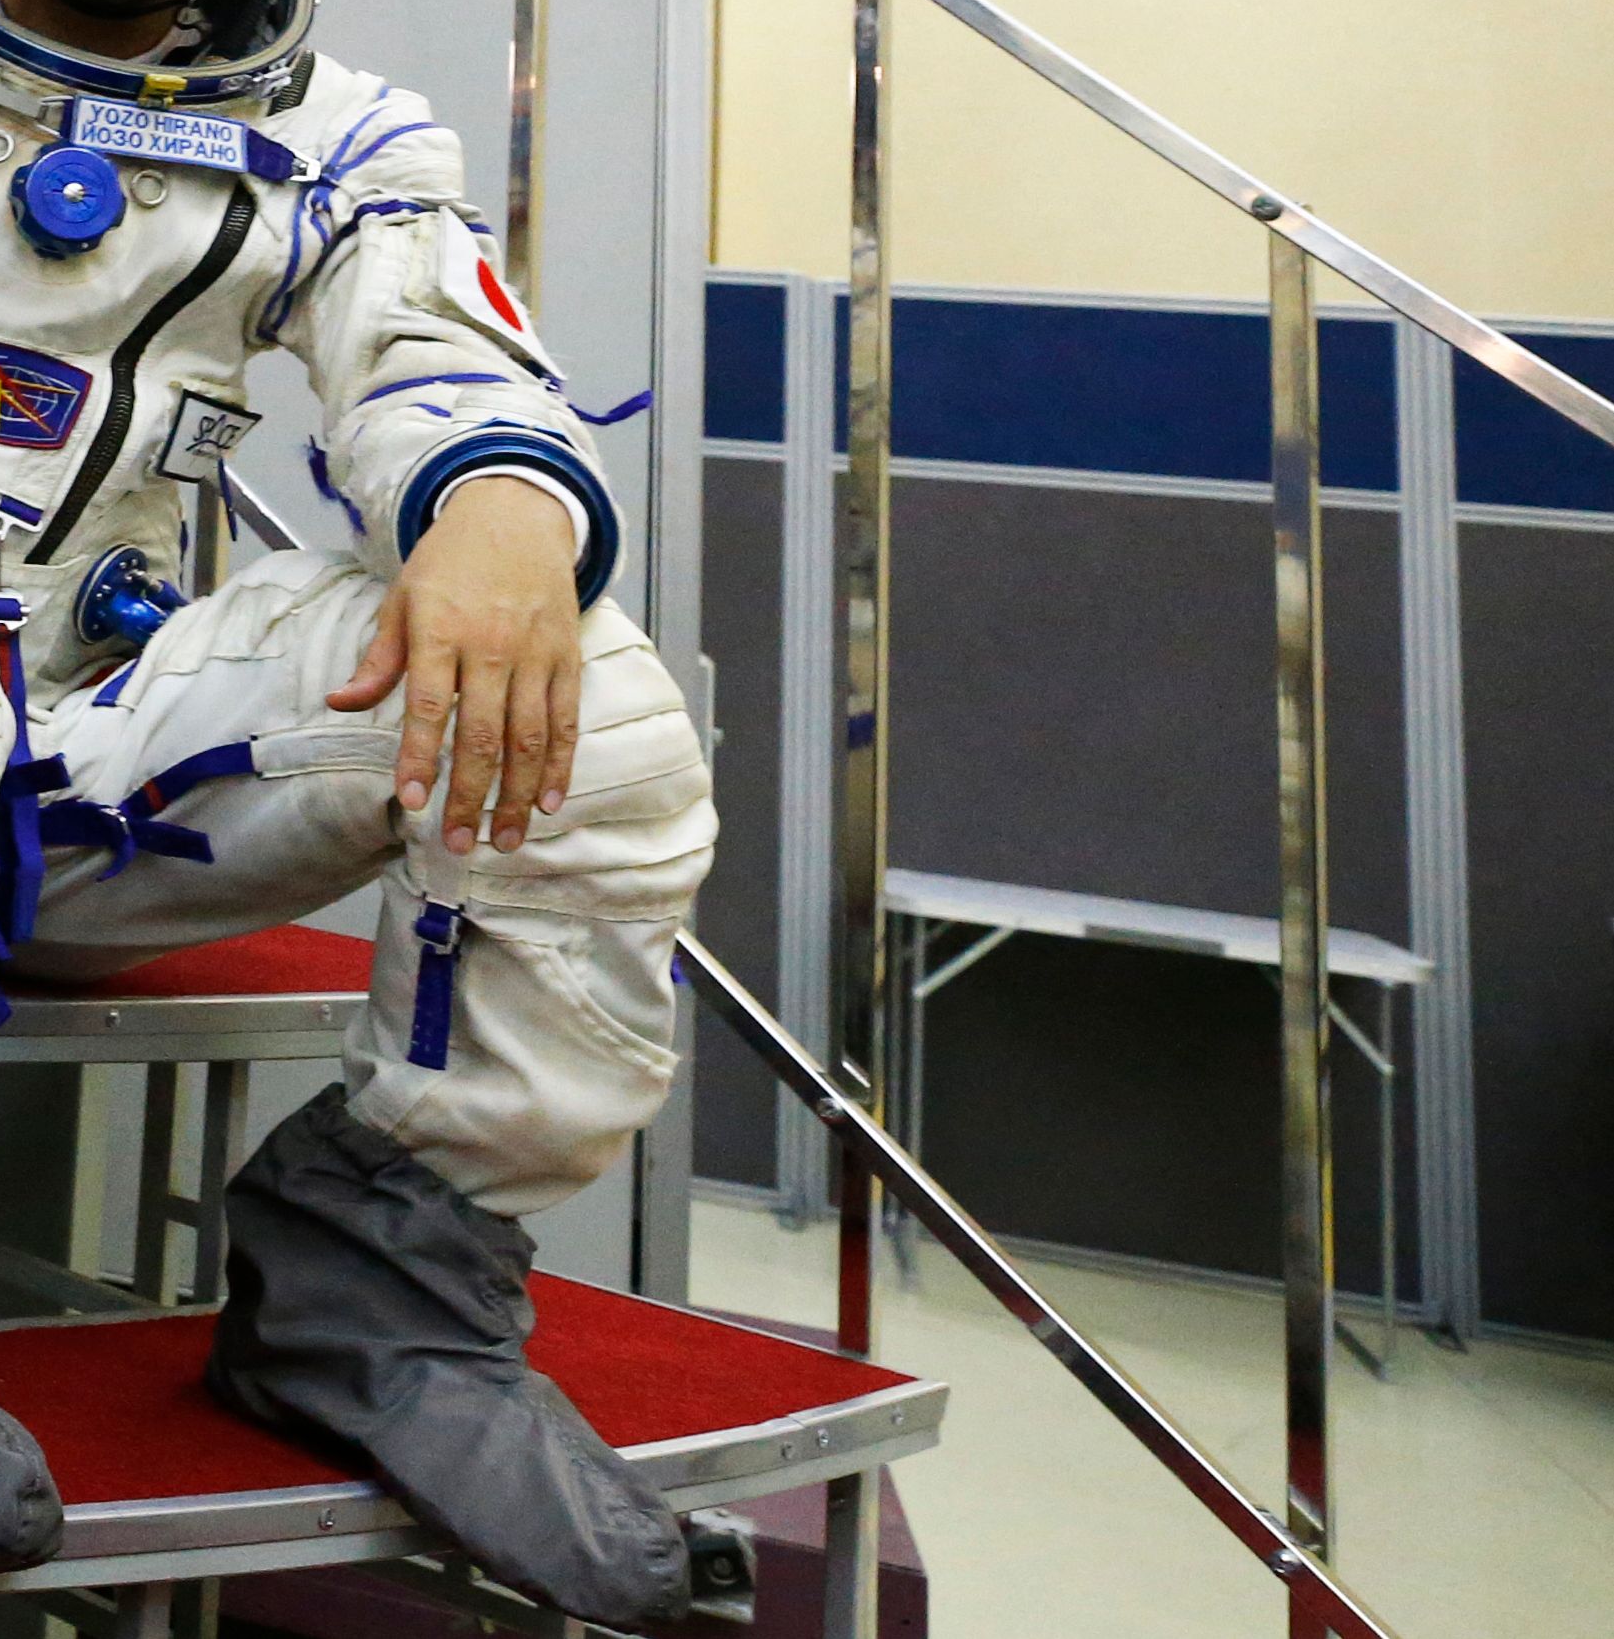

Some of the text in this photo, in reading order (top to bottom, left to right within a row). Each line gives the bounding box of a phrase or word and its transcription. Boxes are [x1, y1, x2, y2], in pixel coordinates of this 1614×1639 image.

[87, 104, 233, 143] YOZO HIRANO
[149, 133, 237, 163] ХИРАНО
